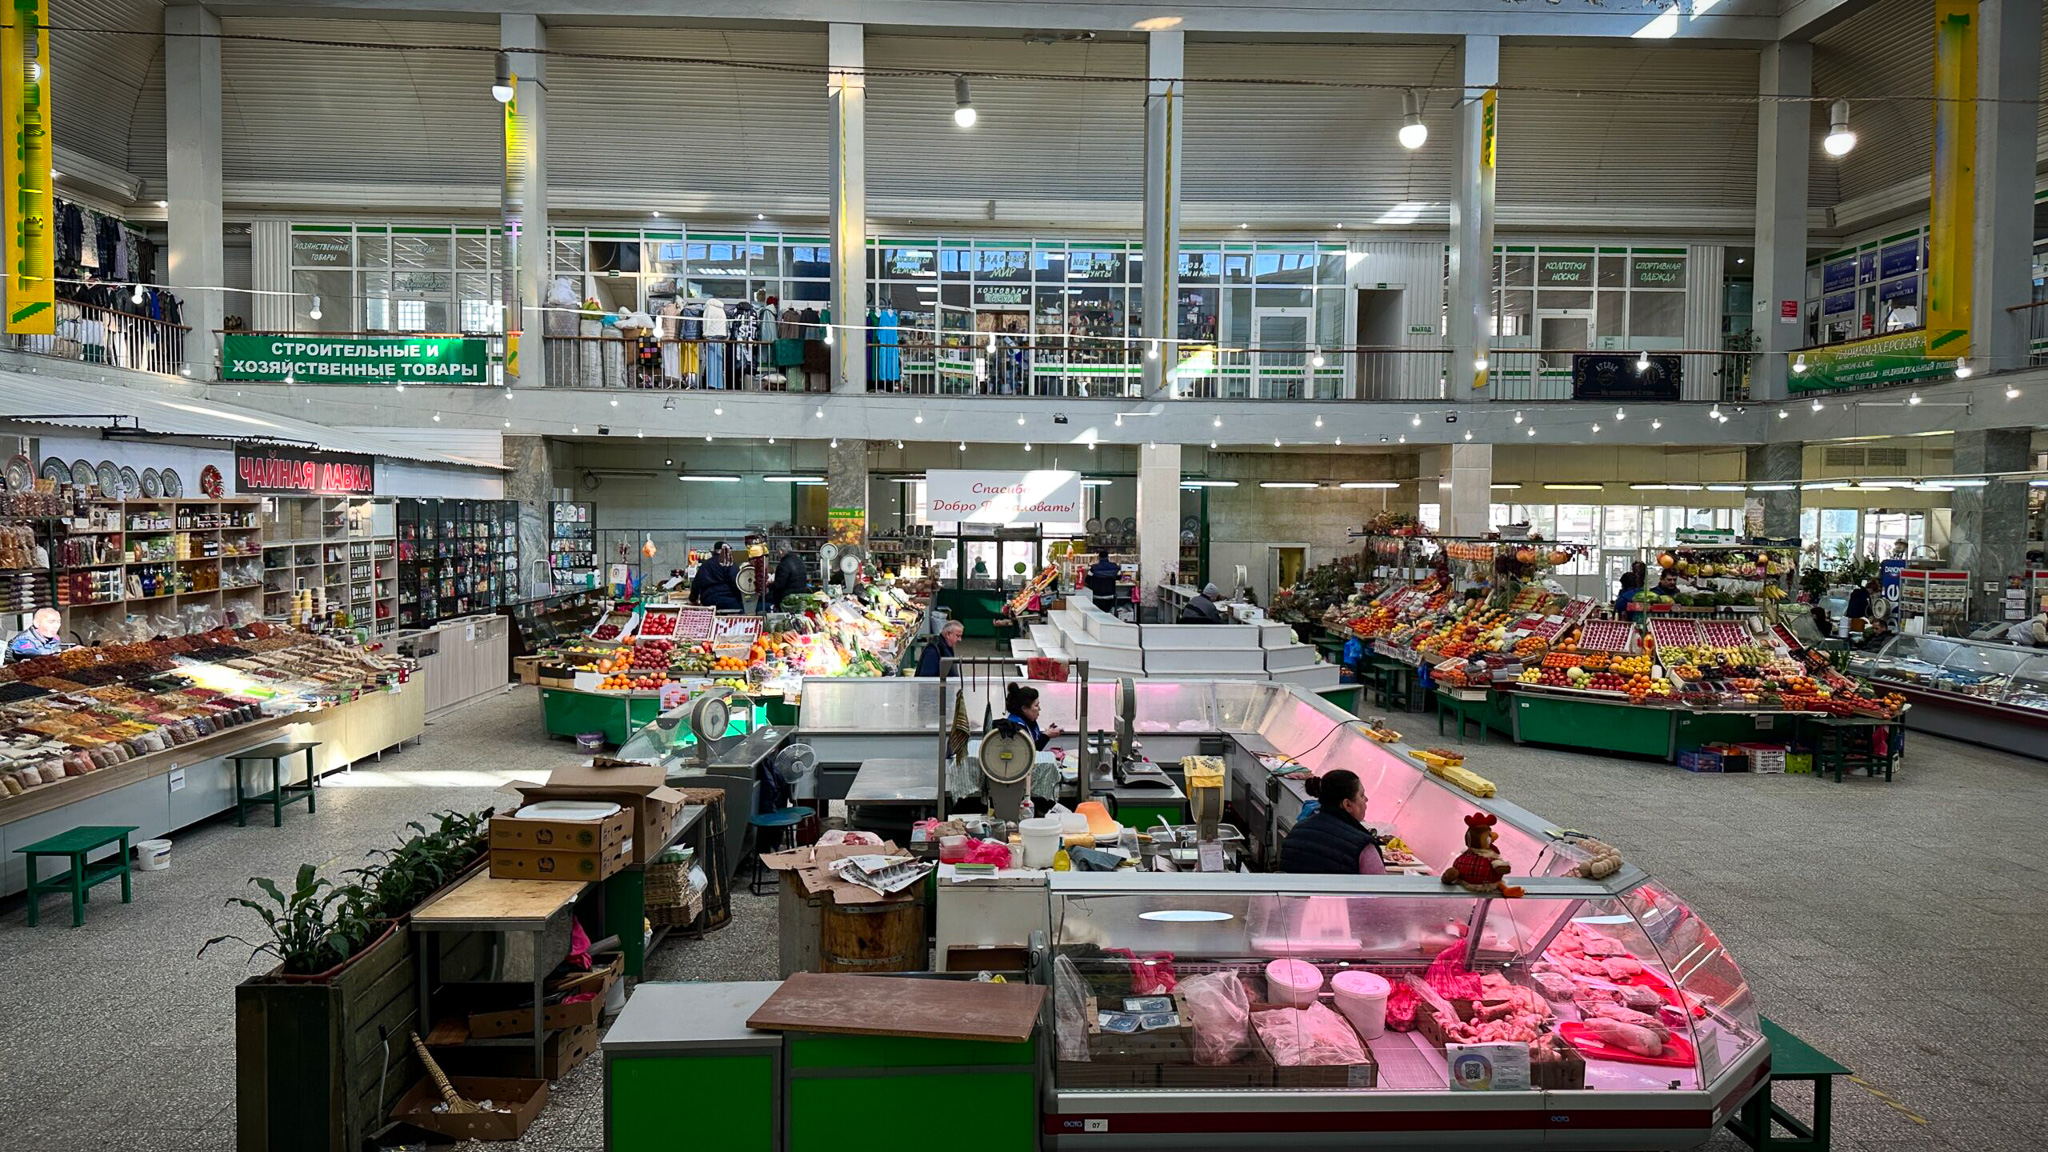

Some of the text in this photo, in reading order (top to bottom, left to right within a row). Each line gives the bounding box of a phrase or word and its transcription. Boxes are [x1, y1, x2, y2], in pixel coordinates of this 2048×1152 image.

[311, 253, 337, 261] ТОВАРЫ
[1544, 261, 1587, 271] КОЛГОТКИ
[1635, 261, 1682, 271] СПОРТИВНАЯ
[990, 267, 1017, 278] МИР
[1551, 272, 1580, 281] НОСКИ
[1640, 272, 1677, 283] ОДЕЖДА
[977, 286, 1030, 295] ХОЗТОВАРЫ
[271, 342, 439, 358] СТРОИТЕЛЬНЫЕ И
[232, 359, 478, 377] ХОЗЯЙСТВЕННЫЕ ТОВАРЫ
[239, 450, 373, 492] ЧАЙНАЯ ЛАВКА
[972, 482, 1031, 494] Спасибо
[933, 499, 977, 513] Добро
